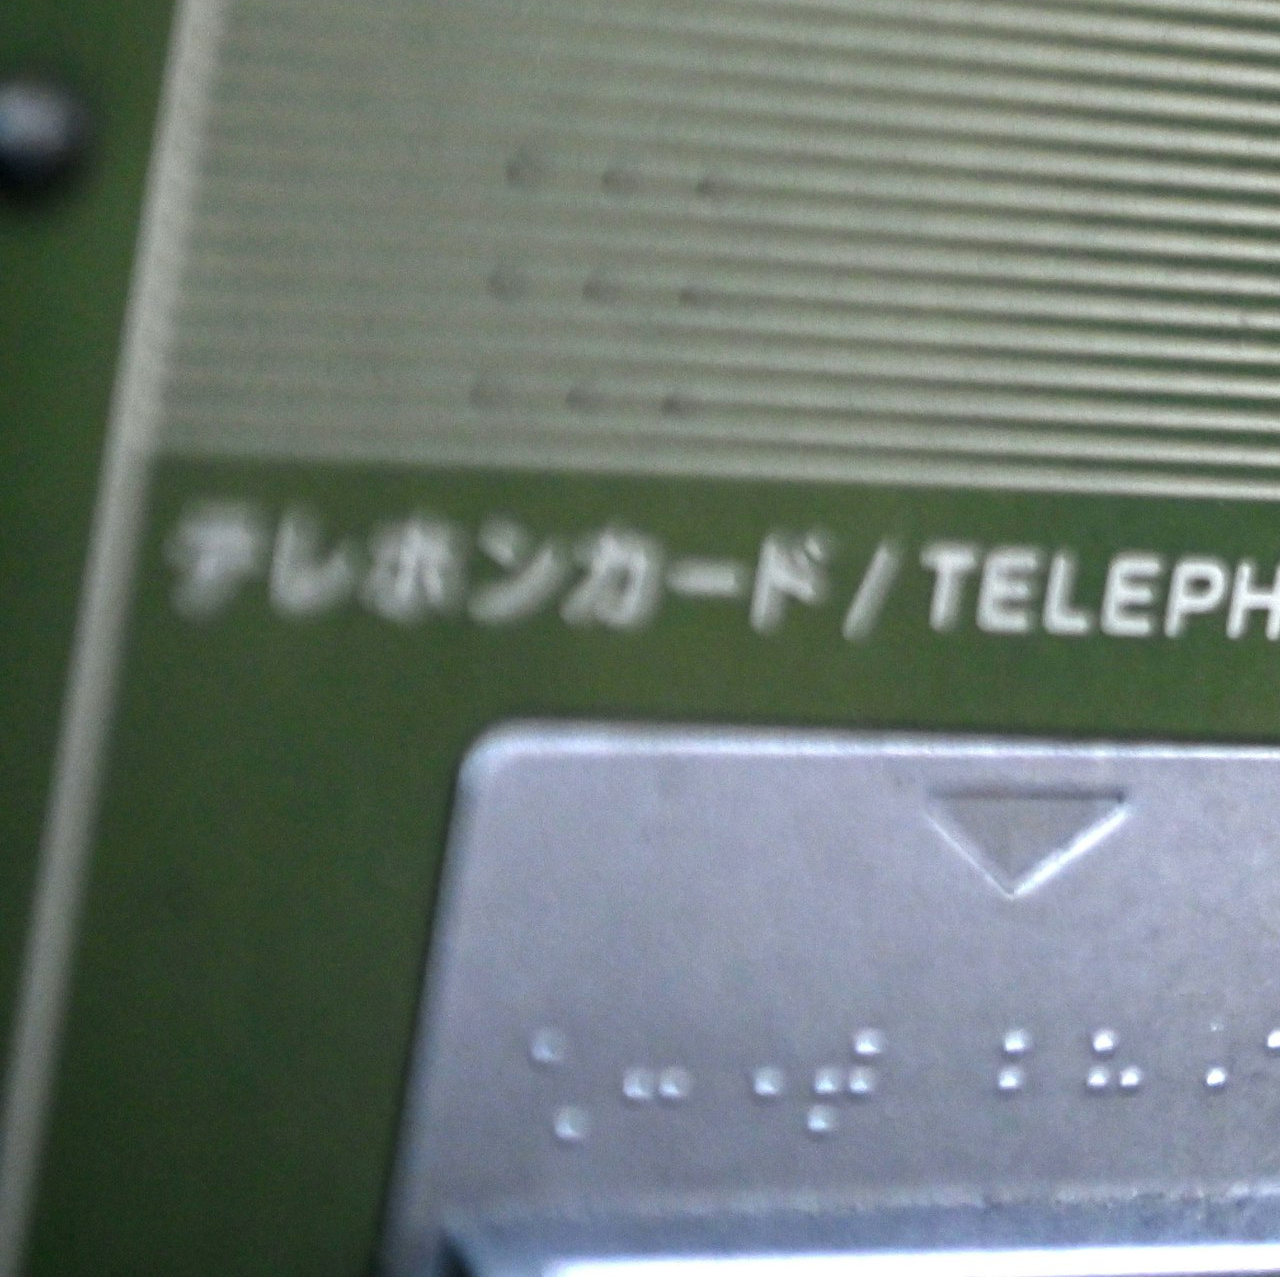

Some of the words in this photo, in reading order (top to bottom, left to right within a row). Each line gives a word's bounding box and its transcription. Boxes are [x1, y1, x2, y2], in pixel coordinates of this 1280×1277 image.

[166, 502, 834, 633] テレホンカード
